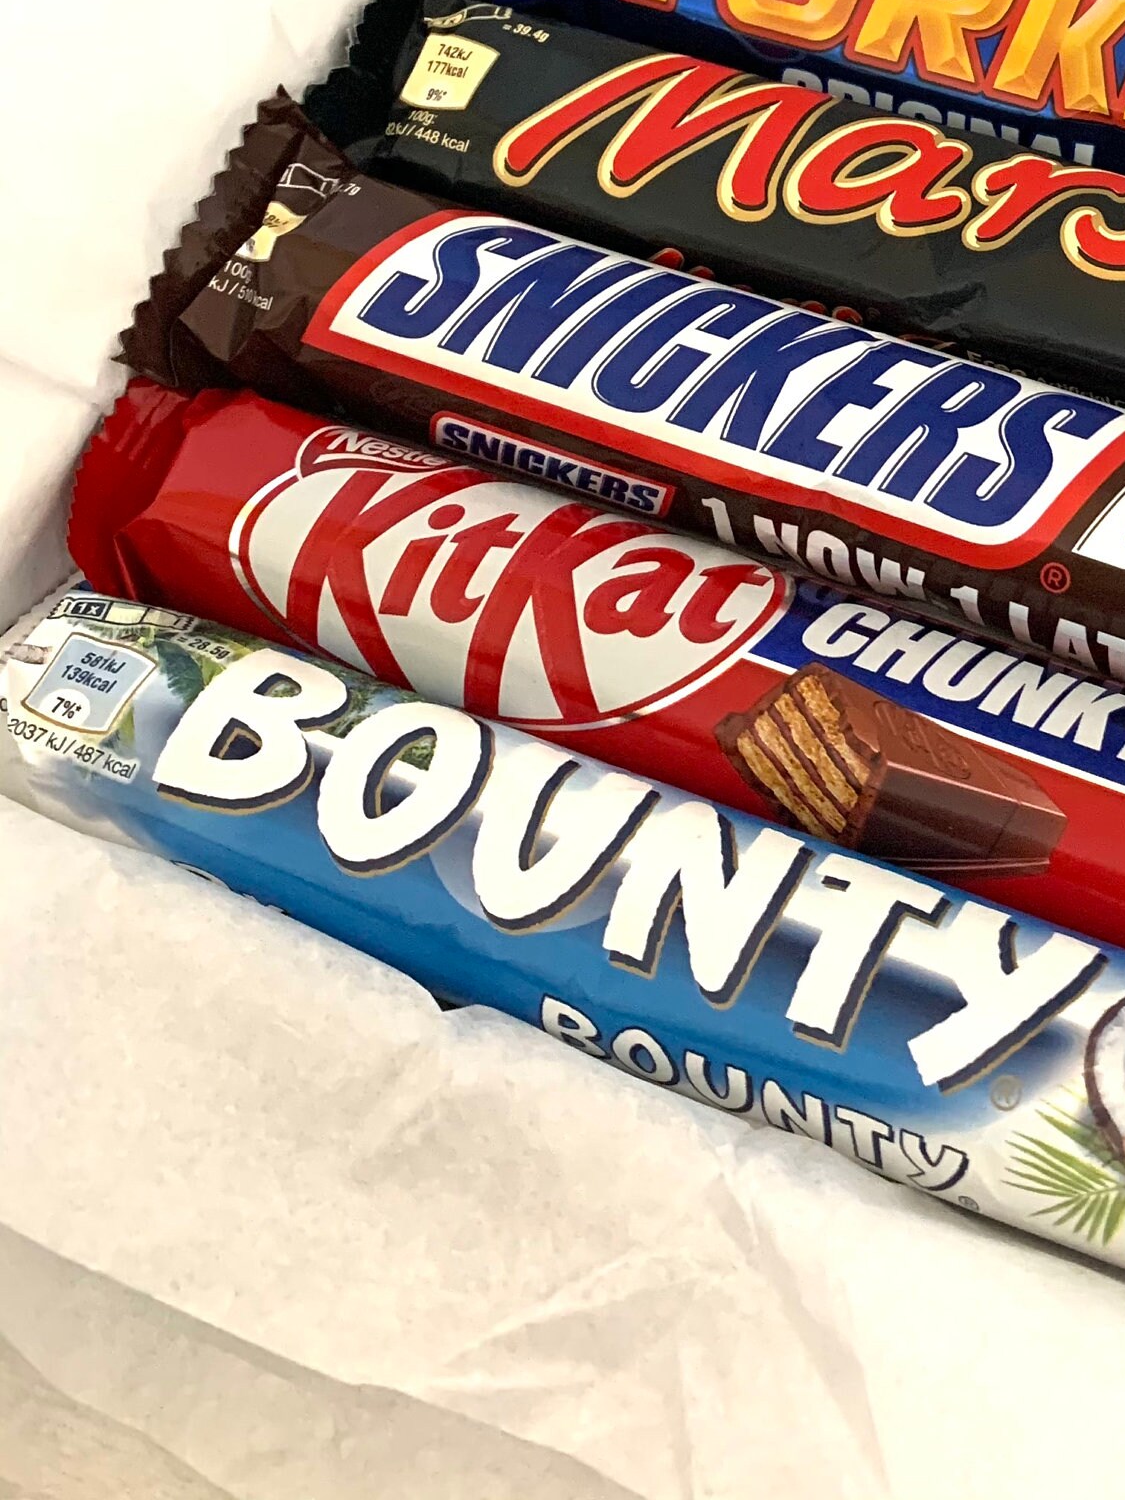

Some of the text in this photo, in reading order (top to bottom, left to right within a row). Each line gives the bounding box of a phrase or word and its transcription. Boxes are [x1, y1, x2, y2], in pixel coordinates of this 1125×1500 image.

[513, 23, 550, 43] 39.4g
[438, 44, 473, 61] 742kJ
[428, 60, 469, 78] 177kcal
[441, 133, 470, 153] kcal
[442, 422, 660, 512] SNICKERS
[284, 468, 770, 720] KitKat
[188, 636, 230, 659] 28.5g
[81, 652, 126, 674] 581kJ
[61, 665, 118, 694] 139kcal
[73, 744, 104, 765] 487
[104, 753, 136, 779] kcal
[153, 648, 1108, 1095] BOUNTY
[541, 995, 969, 1191] BOUNTY
